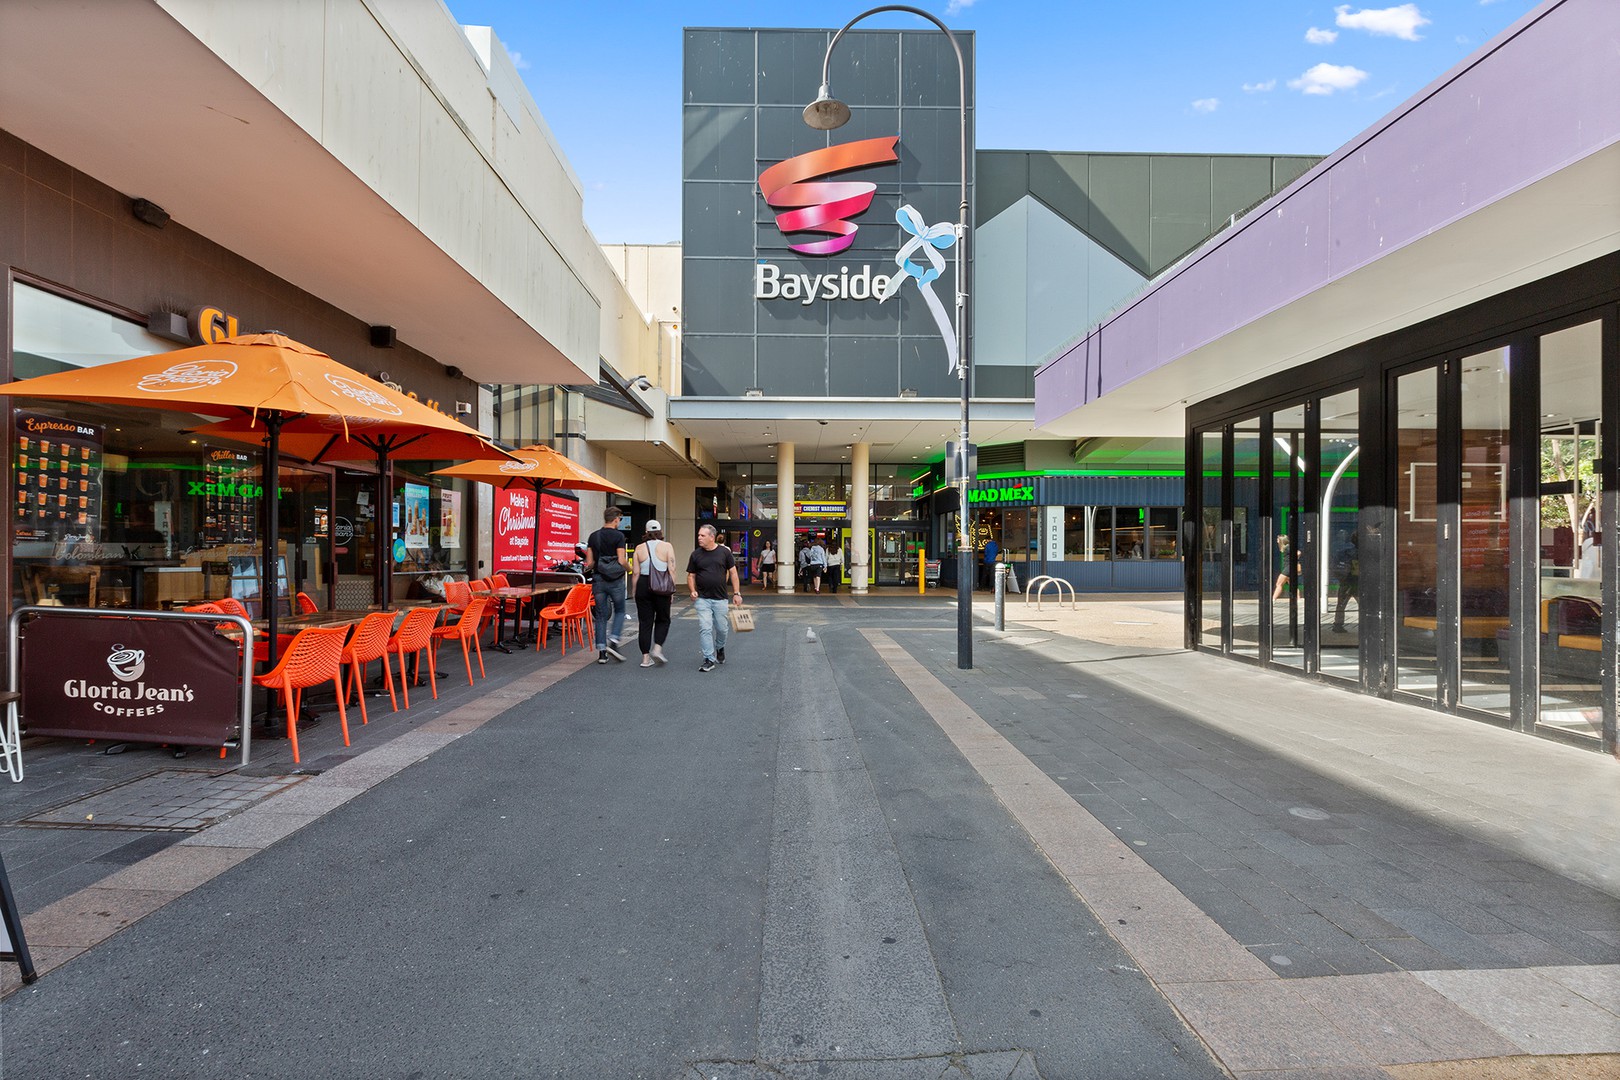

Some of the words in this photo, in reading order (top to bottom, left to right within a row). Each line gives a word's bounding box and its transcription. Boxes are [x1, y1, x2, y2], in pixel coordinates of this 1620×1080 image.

[757, 264, 891, 304] Bayside
[26, 418, 76, 433] Espresso
[77, 426, 95, 436] BAR
[510, 492, 524, 508] Make
[525, 495, 529, 509] it
[968, 487, 999, 503] MAD
[1000, 486, 1034, 502] MEX
[499, 507, 536, 536] Christma
[64, 680, 131, 700] Gloria
[135, 682, 194, 702] Jean's
[93, 701, 165, 717] COFFEES
